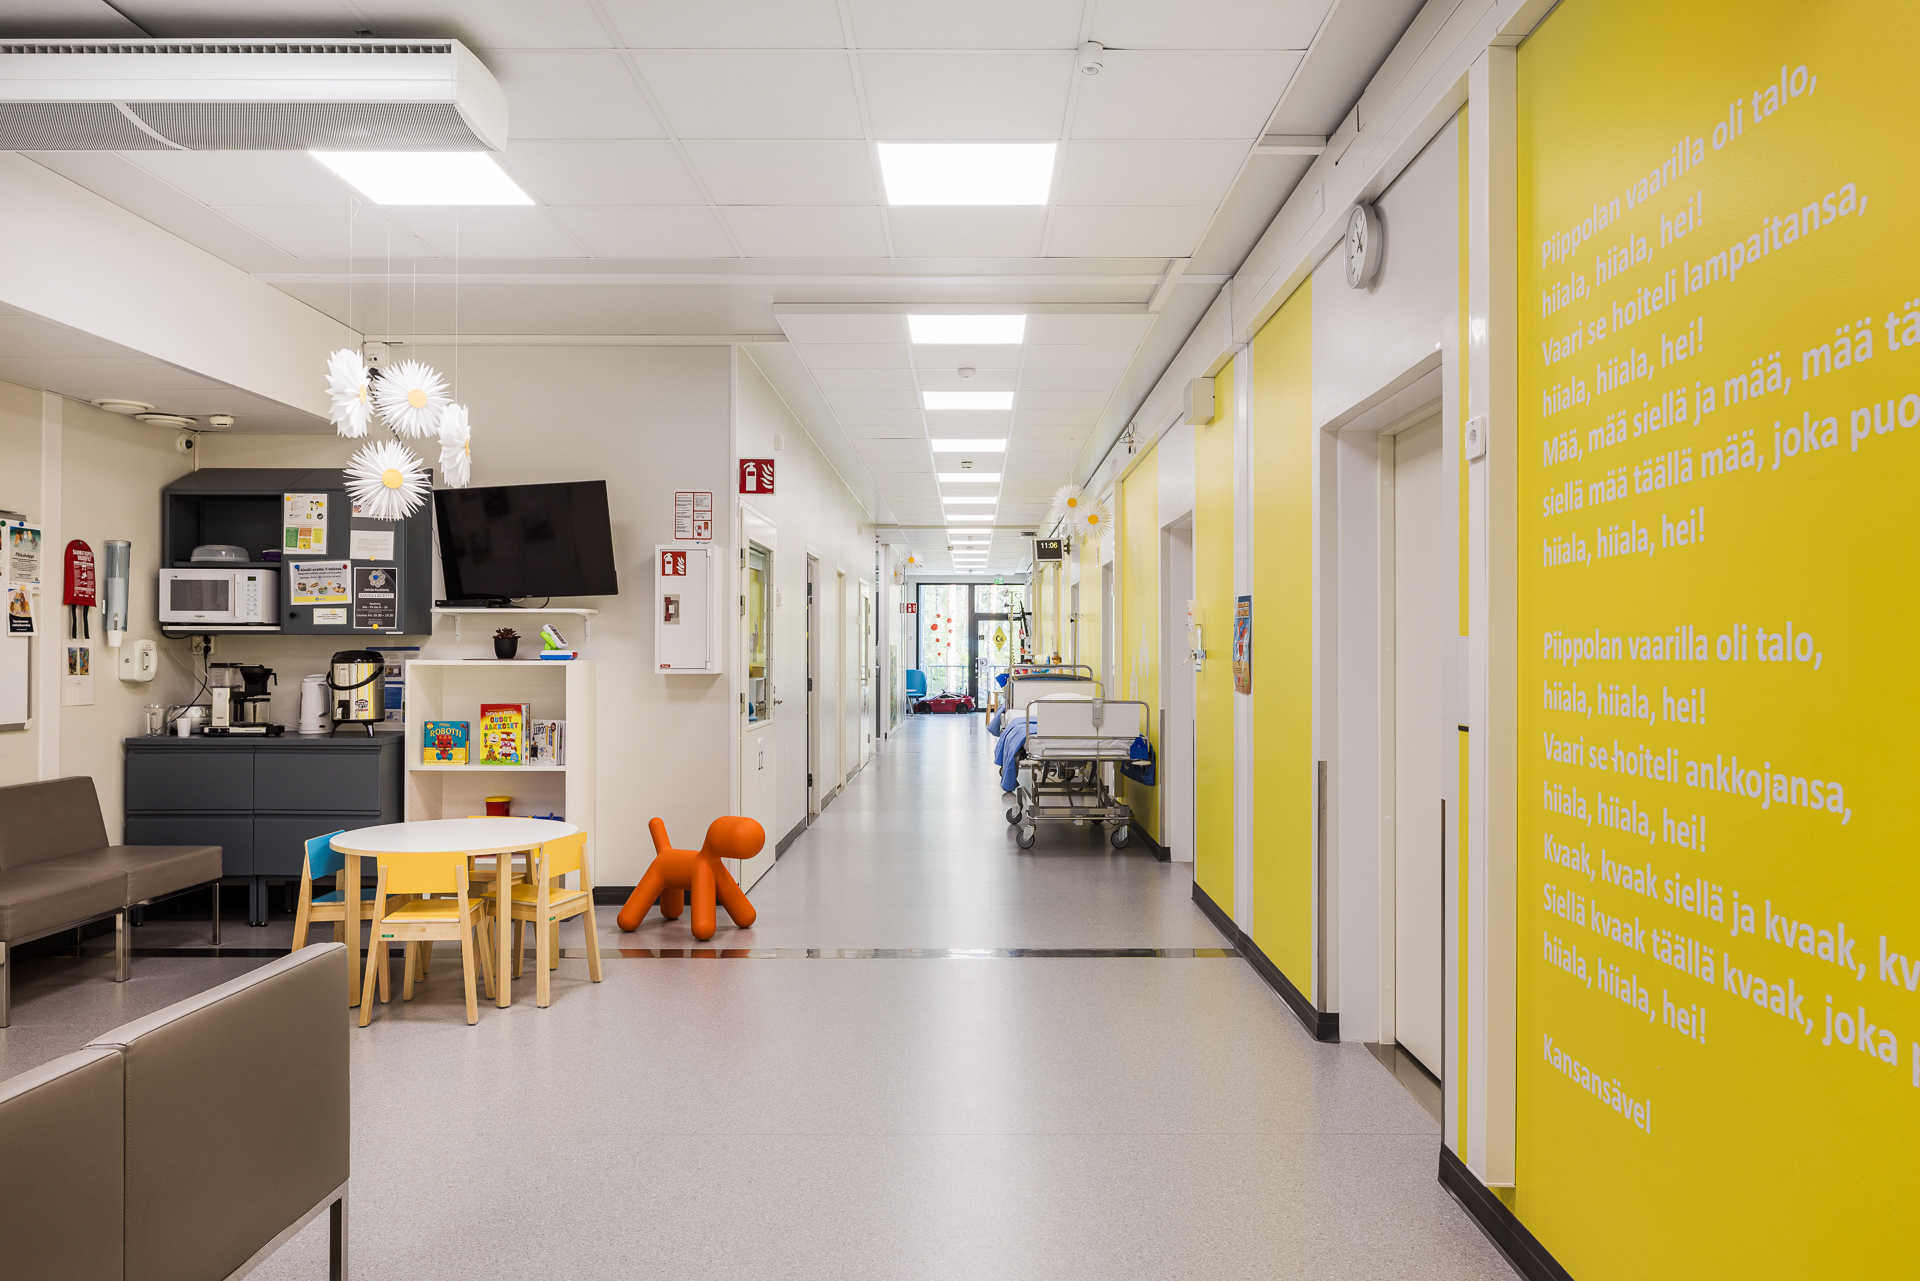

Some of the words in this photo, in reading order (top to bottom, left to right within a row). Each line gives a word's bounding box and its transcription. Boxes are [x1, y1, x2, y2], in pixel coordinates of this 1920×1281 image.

[1542, 197, 1621, 269] Piippolan
[1626, 135, 1705, 210] vaarilla
[1712, 98, 1744, 150] oli
[1751, 64, 1818, 123] talo,
[1542, 272, 1591, 319] hiiala,
[1596, 233, 1654, 287] hiiala,
[1661, 190, 1703, 248] hei!
[1542, 320, 1583, 367] Vaari
[1588, 317, 1608, 345] se
[1612, 269, 1677, 333] hoiteli
[1684, 182, 1869, 296] lampaitansa,
[1543, 376, 1592, 418] hiiala,
[1597, 348, 1655, 395] hiiala,
[1661, 316, 1704, 368] hei!
[1543, 428, 1584, 467] Mää,
[1588, 410, 1628, 452] mää
[1633, 387, 1688, 437] siellä
[1693, 381, 1716, 426] ja
[1724, 351, 1792, 407] mää,
[1802, 316, 1874, 381] mää
[1543, 479, 1584, 517] siellä
[1589, 466, 1628, 506] mää
[1633, 447, 1694, 494] täällä
[1701, 429, 1765, 478] mää,
[1772, 411, 1839, 471] joka
[1851, 394, 1920, 452] puo
[1040, 541, 1058, 549] 11:06
[1543, 532, 1592, 567] hiiala,
[1597, 520, 1656, 558] hiiala,
[1662, 506, 1705, 548] hei!
[1544, 628, 1623, 667] Piippolan
[1628, 625, 1709, 661] vaarilla
[1716, 623, 1748, 661] oli
[1755, 621, 1824, 670] talo,
[430, 727, 462, 738] ROBOTTI
[484, 722, 519, 731] AAKKOSET
[490, 716, 513, 724] OUDOT
[1544, 680, 1593, 719] hiiala,
[1598, 683, 1657, 726] hiiala,
[1663, 686, 1707, 725] hei!
[1543, 732, 1585, 766] Vaari
[1589, 746, 1609, 770] se
[1613, 740, 1680, 783] hoiteli
[1686, 754, 1853, 825] ankkojansa,
[1544, 780, 1593, 827] hiiala,
[1598, 792, 1657, 845] hiiala,
[1663, 807, 1707, 852] hei!
[1544, 832, 1597, 882] Kvaak,
[1601, 849, 1659, 899] kvaak
[1664, 872, 1725, 923] siellä
[1730, 890, 1756, 937] ja
[1765, 899, 1867, 981] kvaak,
[1543, 883, 1586, 927] Siellä
[1591, 900, 1647, 954] kvaak
[1651, 929, 1716, 984] täällä
[1723, 952, 1815, 1035] kvaak,
[1822, 994, 1899, 1066] joka
[1544, 931, 1593, 989] hiiala,
[1598, 957, 1657, 1023] hiiala,
[1663, 989, 1707, 1045] hei!
[1544, 1033, 1652, 1134] Kansansävel
